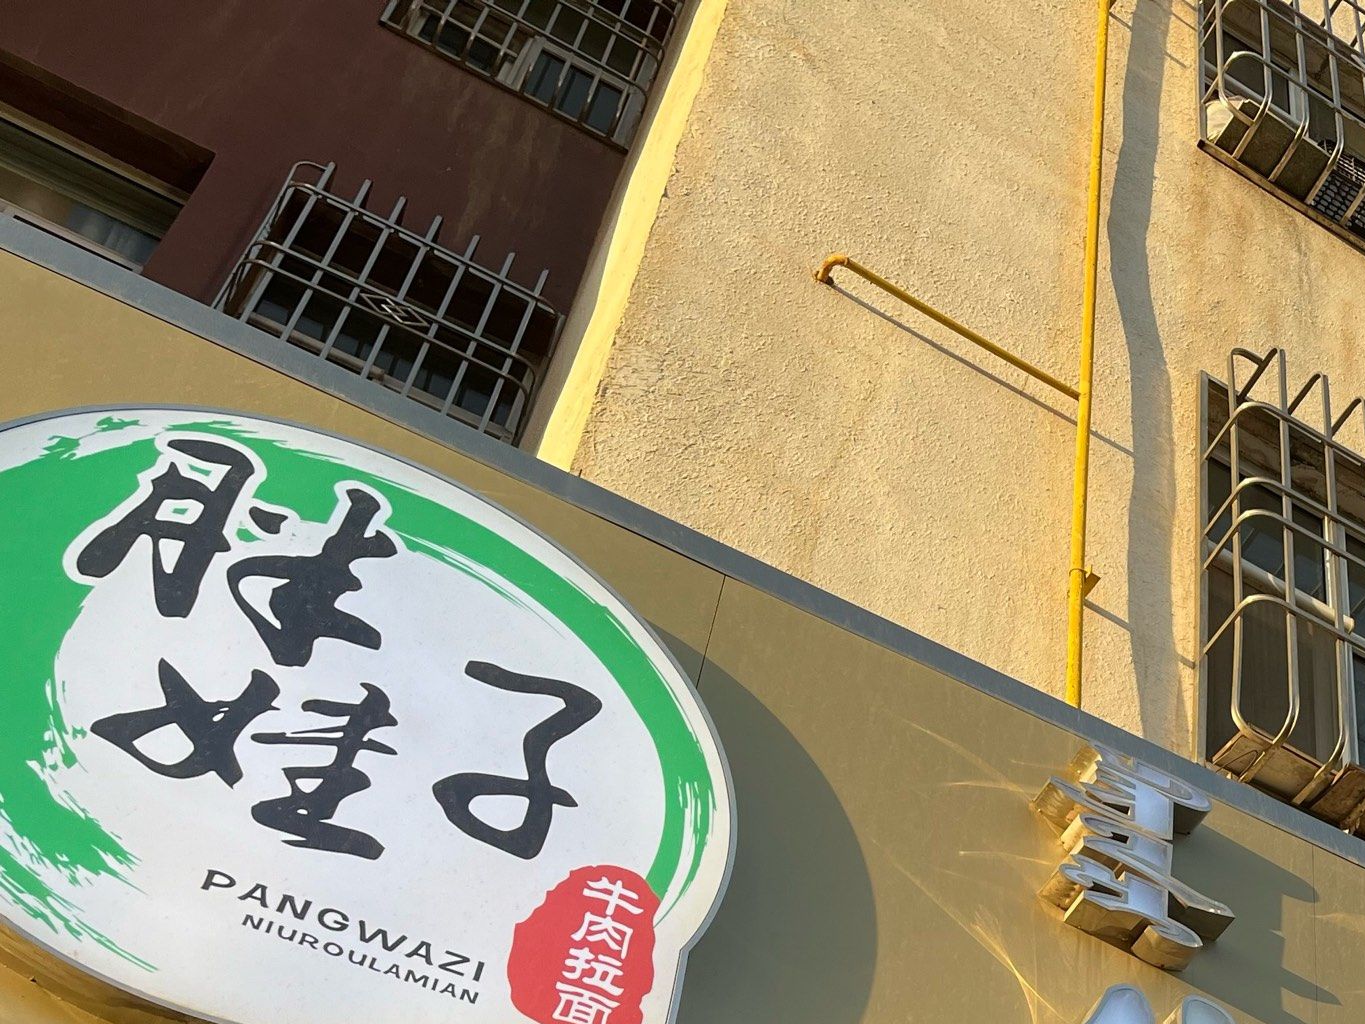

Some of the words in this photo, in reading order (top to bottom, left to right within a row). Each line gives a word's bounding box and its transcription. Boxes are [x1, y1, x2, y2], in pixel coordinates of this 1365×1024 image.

[77, 437, 604, 861] 胖娃子
[200, 867, 488, 984] PANGWAZI
[242, 911, 481, 1006] NIUROULAMIAN
